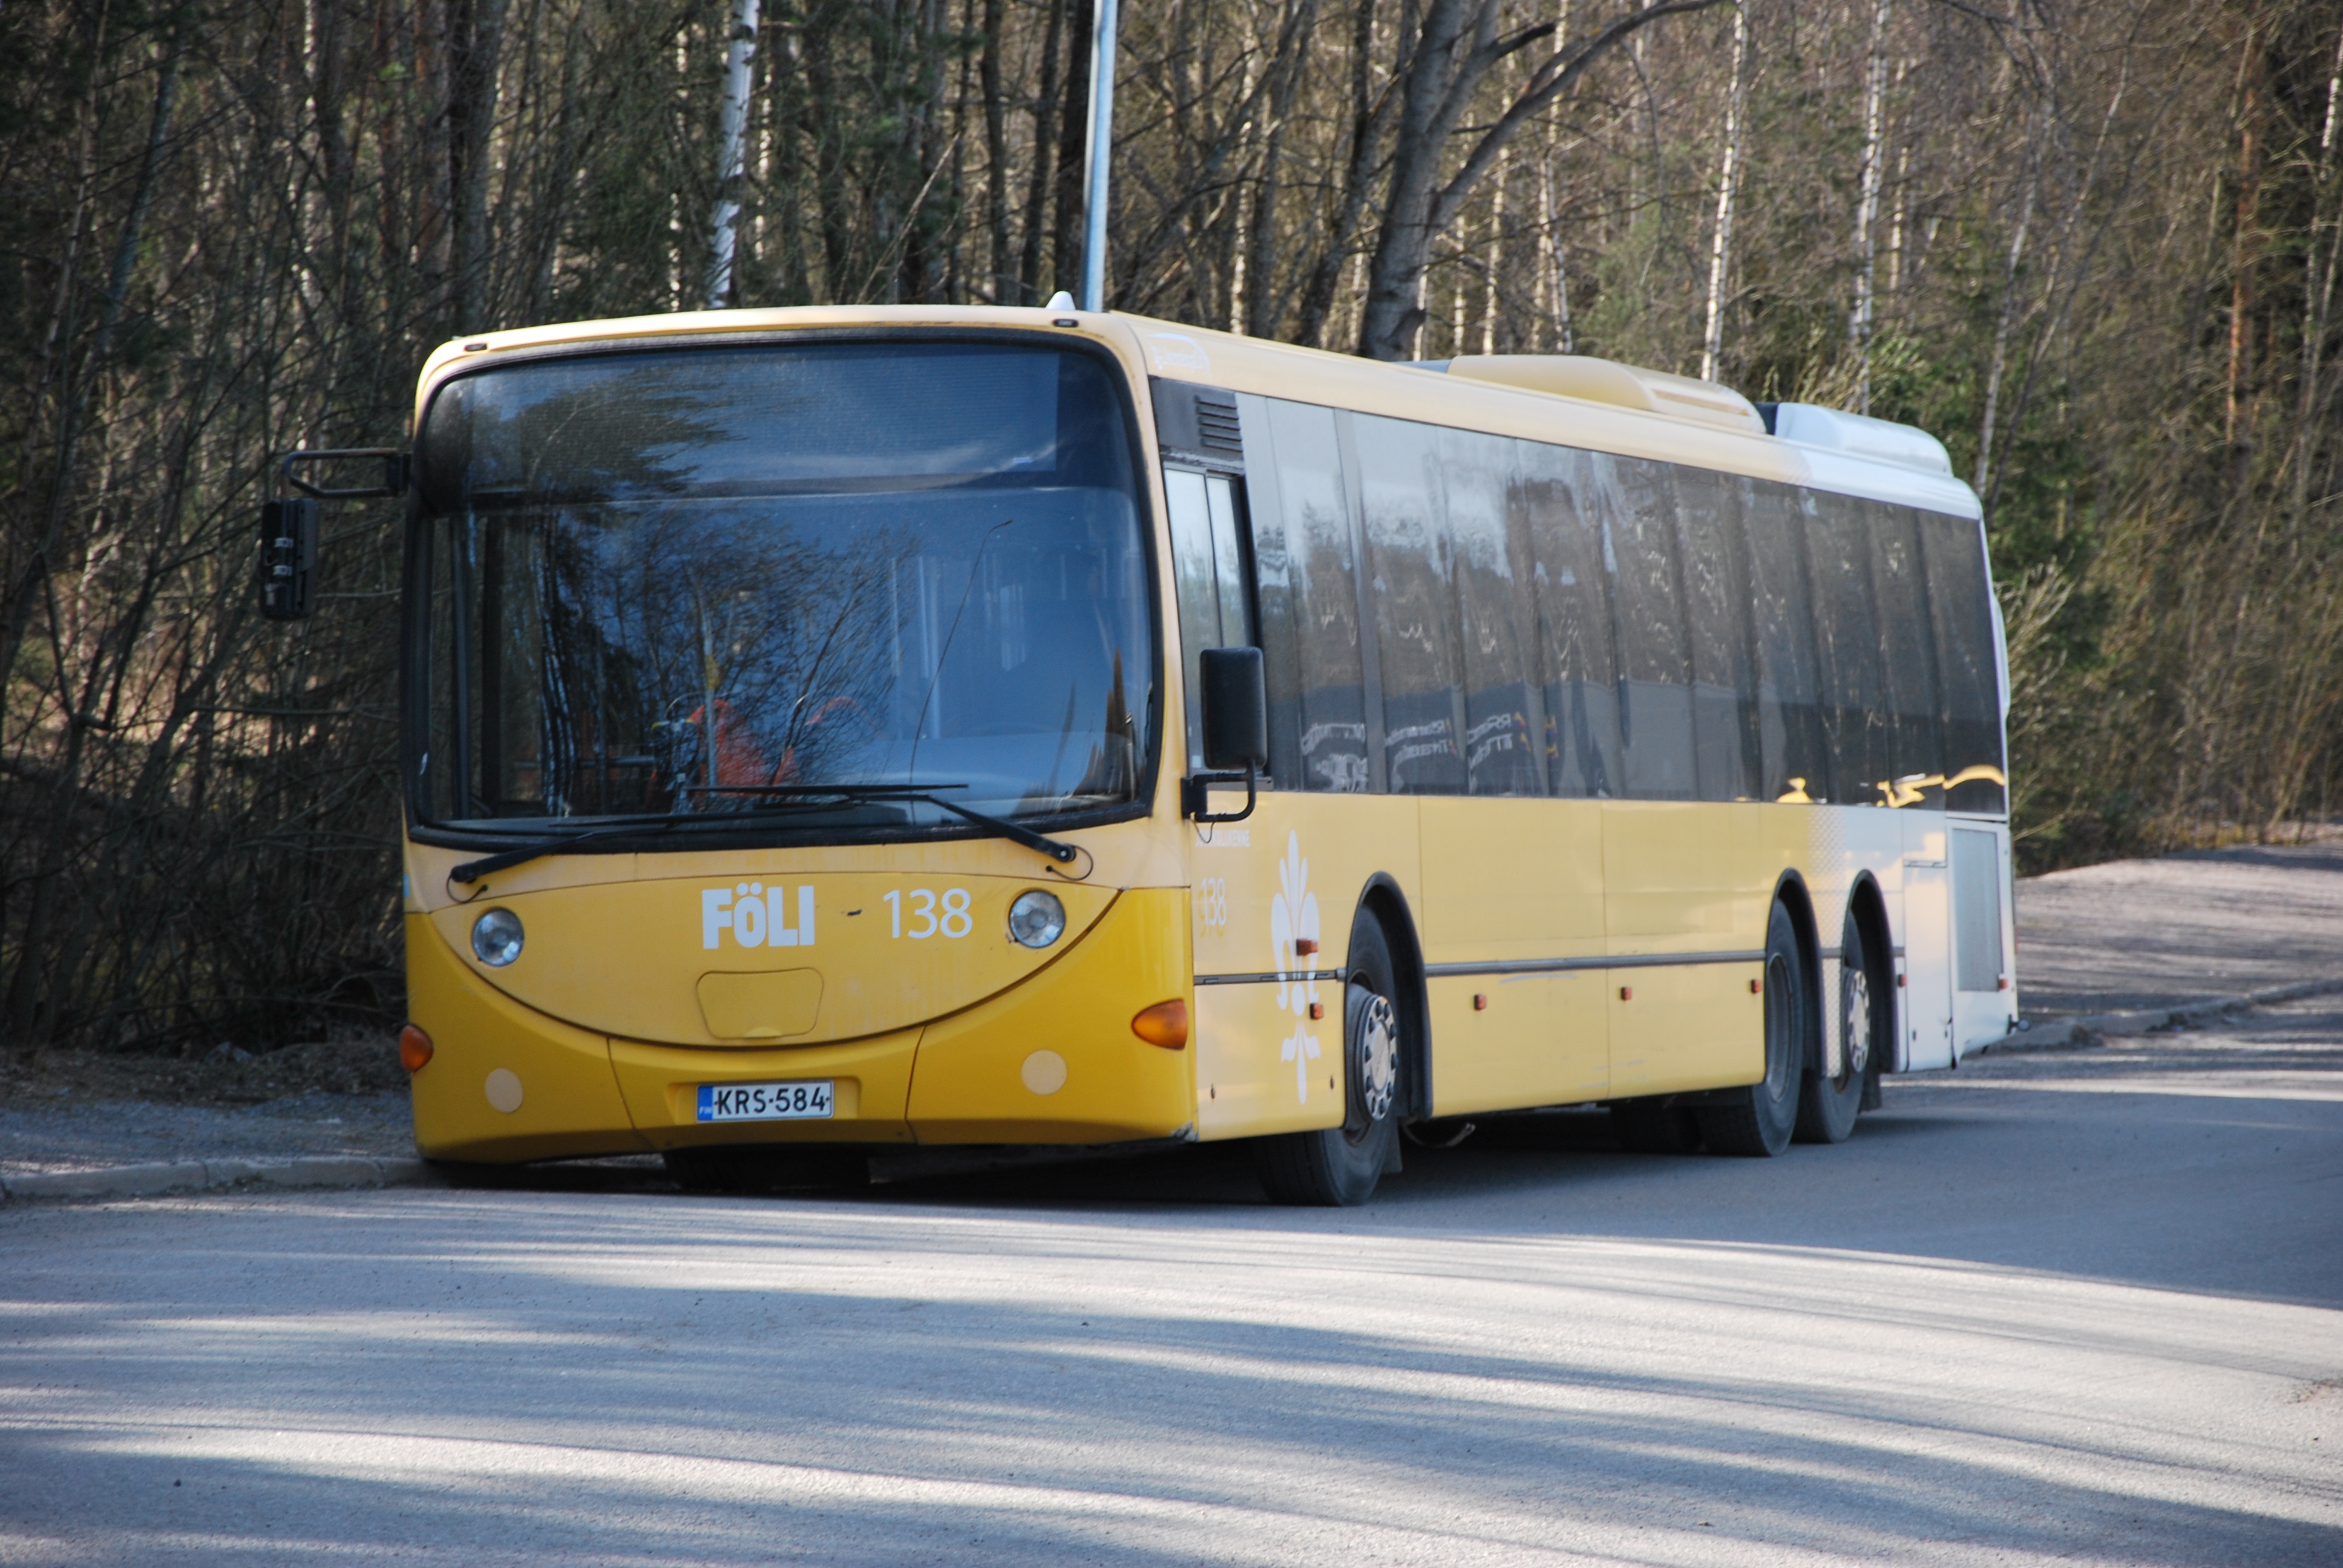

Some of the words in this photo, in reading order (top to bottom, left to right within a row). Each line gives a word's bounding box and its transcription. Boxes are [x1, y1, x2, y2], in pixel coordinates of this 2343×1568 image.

[702, 882, 815, 949] FÖLI
[883, 888, 973, 938] 138
[1201, 877, 1227, 926] 138
[716, 1087, 827, 1115] KRS-584
